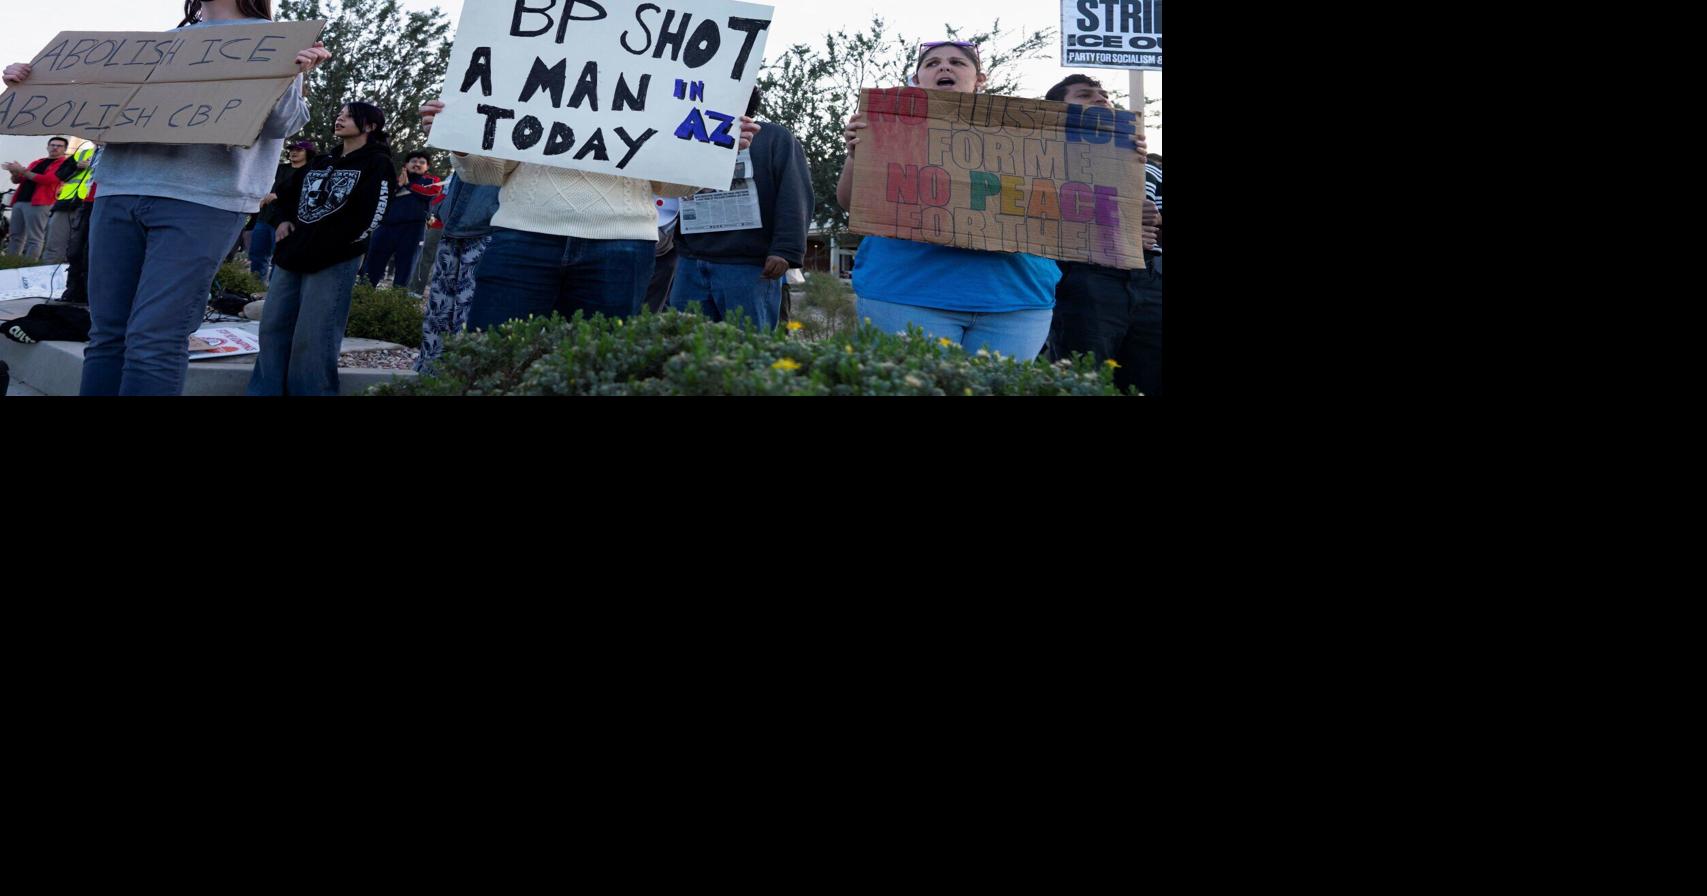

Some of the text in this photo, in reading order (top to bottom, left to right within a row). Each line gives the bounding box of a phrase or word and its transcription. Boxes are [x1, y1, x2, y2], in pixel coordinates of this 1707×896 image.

[31, 36, 287, 72] ABOLISH ICE
[510, 0, 772, 81] BP SHOT
[1067, 34, 1162, 49] ICE O
[1069, 52, 1096, 62] PARTY
[1096, 54, 1111, 63] FOR
[1112, 54, 1155, 64] SOCIALISM
[459, 47, 652, 112] A MAN
[673, 79, 705, 102] IN
[0, 92, 242, 130] ABOLISH CBP
[867, 87, 929, 126] NO
[476, 103, 659, 169] TODAY
[673, 107, 735, 149] AZ
[928, 128, 1094, 184] FOR ME
[886, 162, 1120, 227] NO PEACE
[896, 204, 987, 249] FOR
